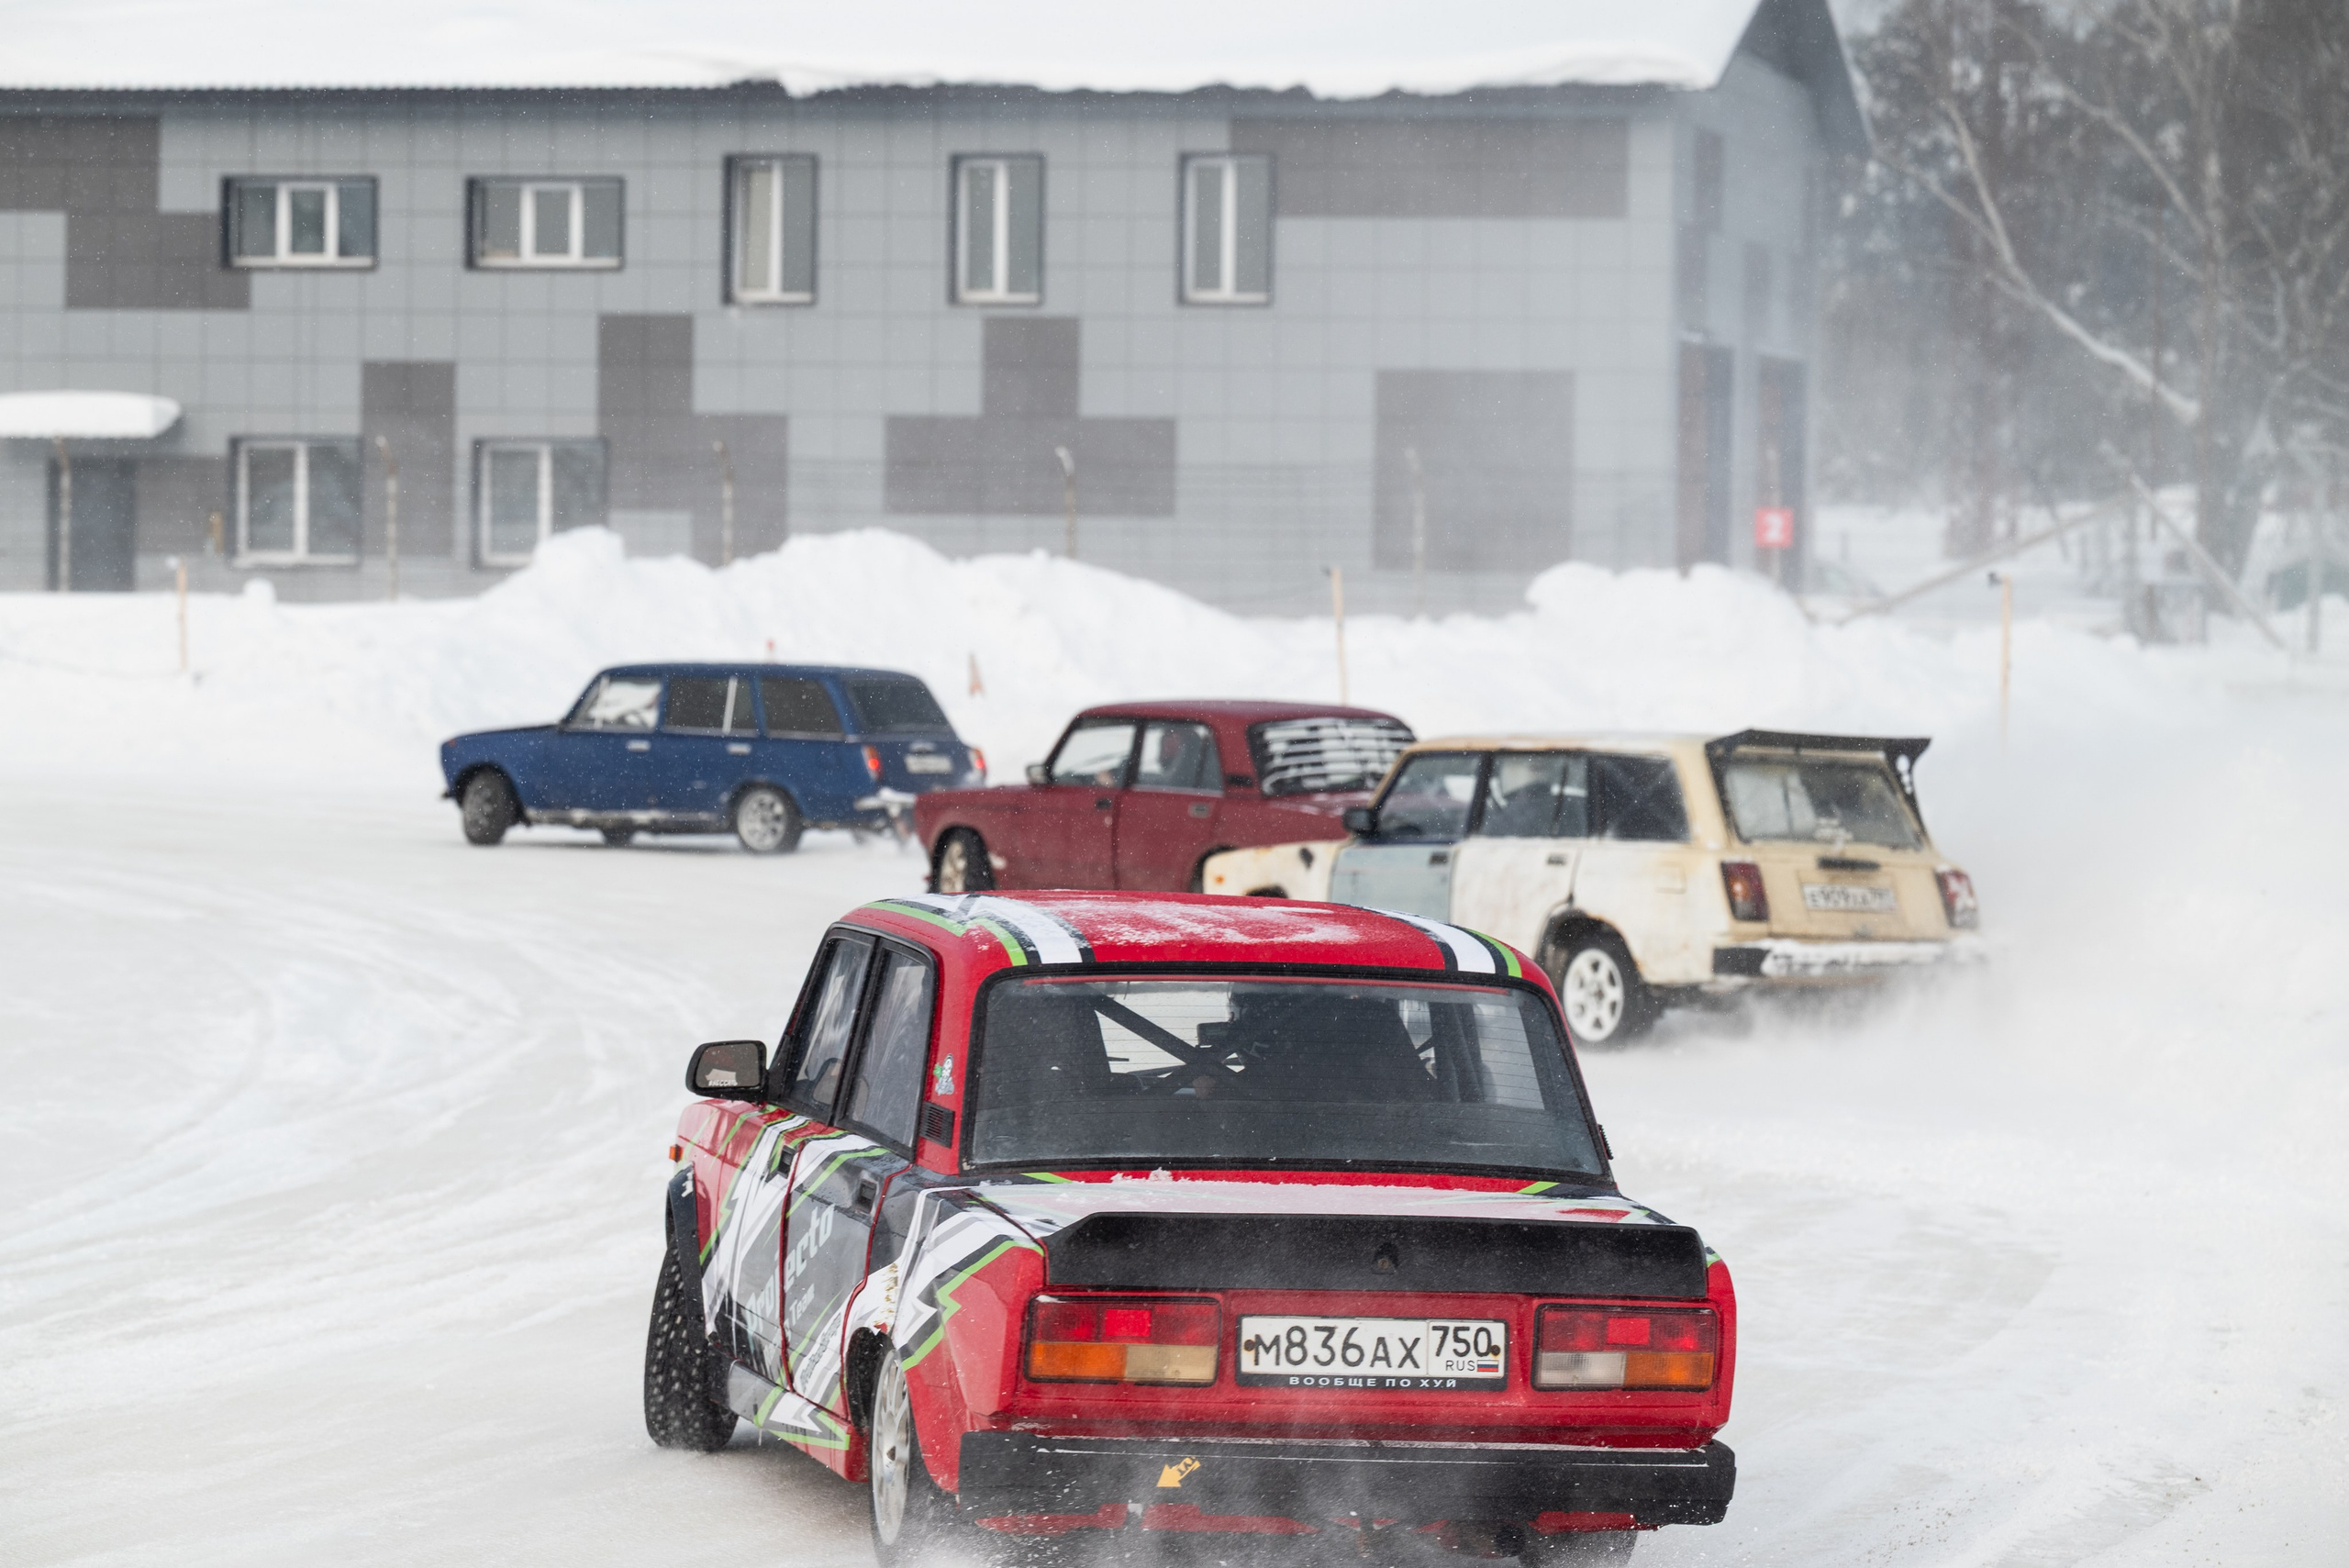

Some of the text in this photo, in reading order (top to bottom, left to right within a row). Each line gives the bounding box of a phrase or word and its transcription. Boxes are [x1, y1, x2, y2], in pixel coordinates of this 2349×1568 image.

[1764, 513, 1783, 542] 2
[1253, 1325, 1492, 1369] М836АХ 750
[1445, 1360, 1475, 1372] RUS
[1289, 1376, 1456, 1388] ВООБЩЕ ПО ХУЙ
